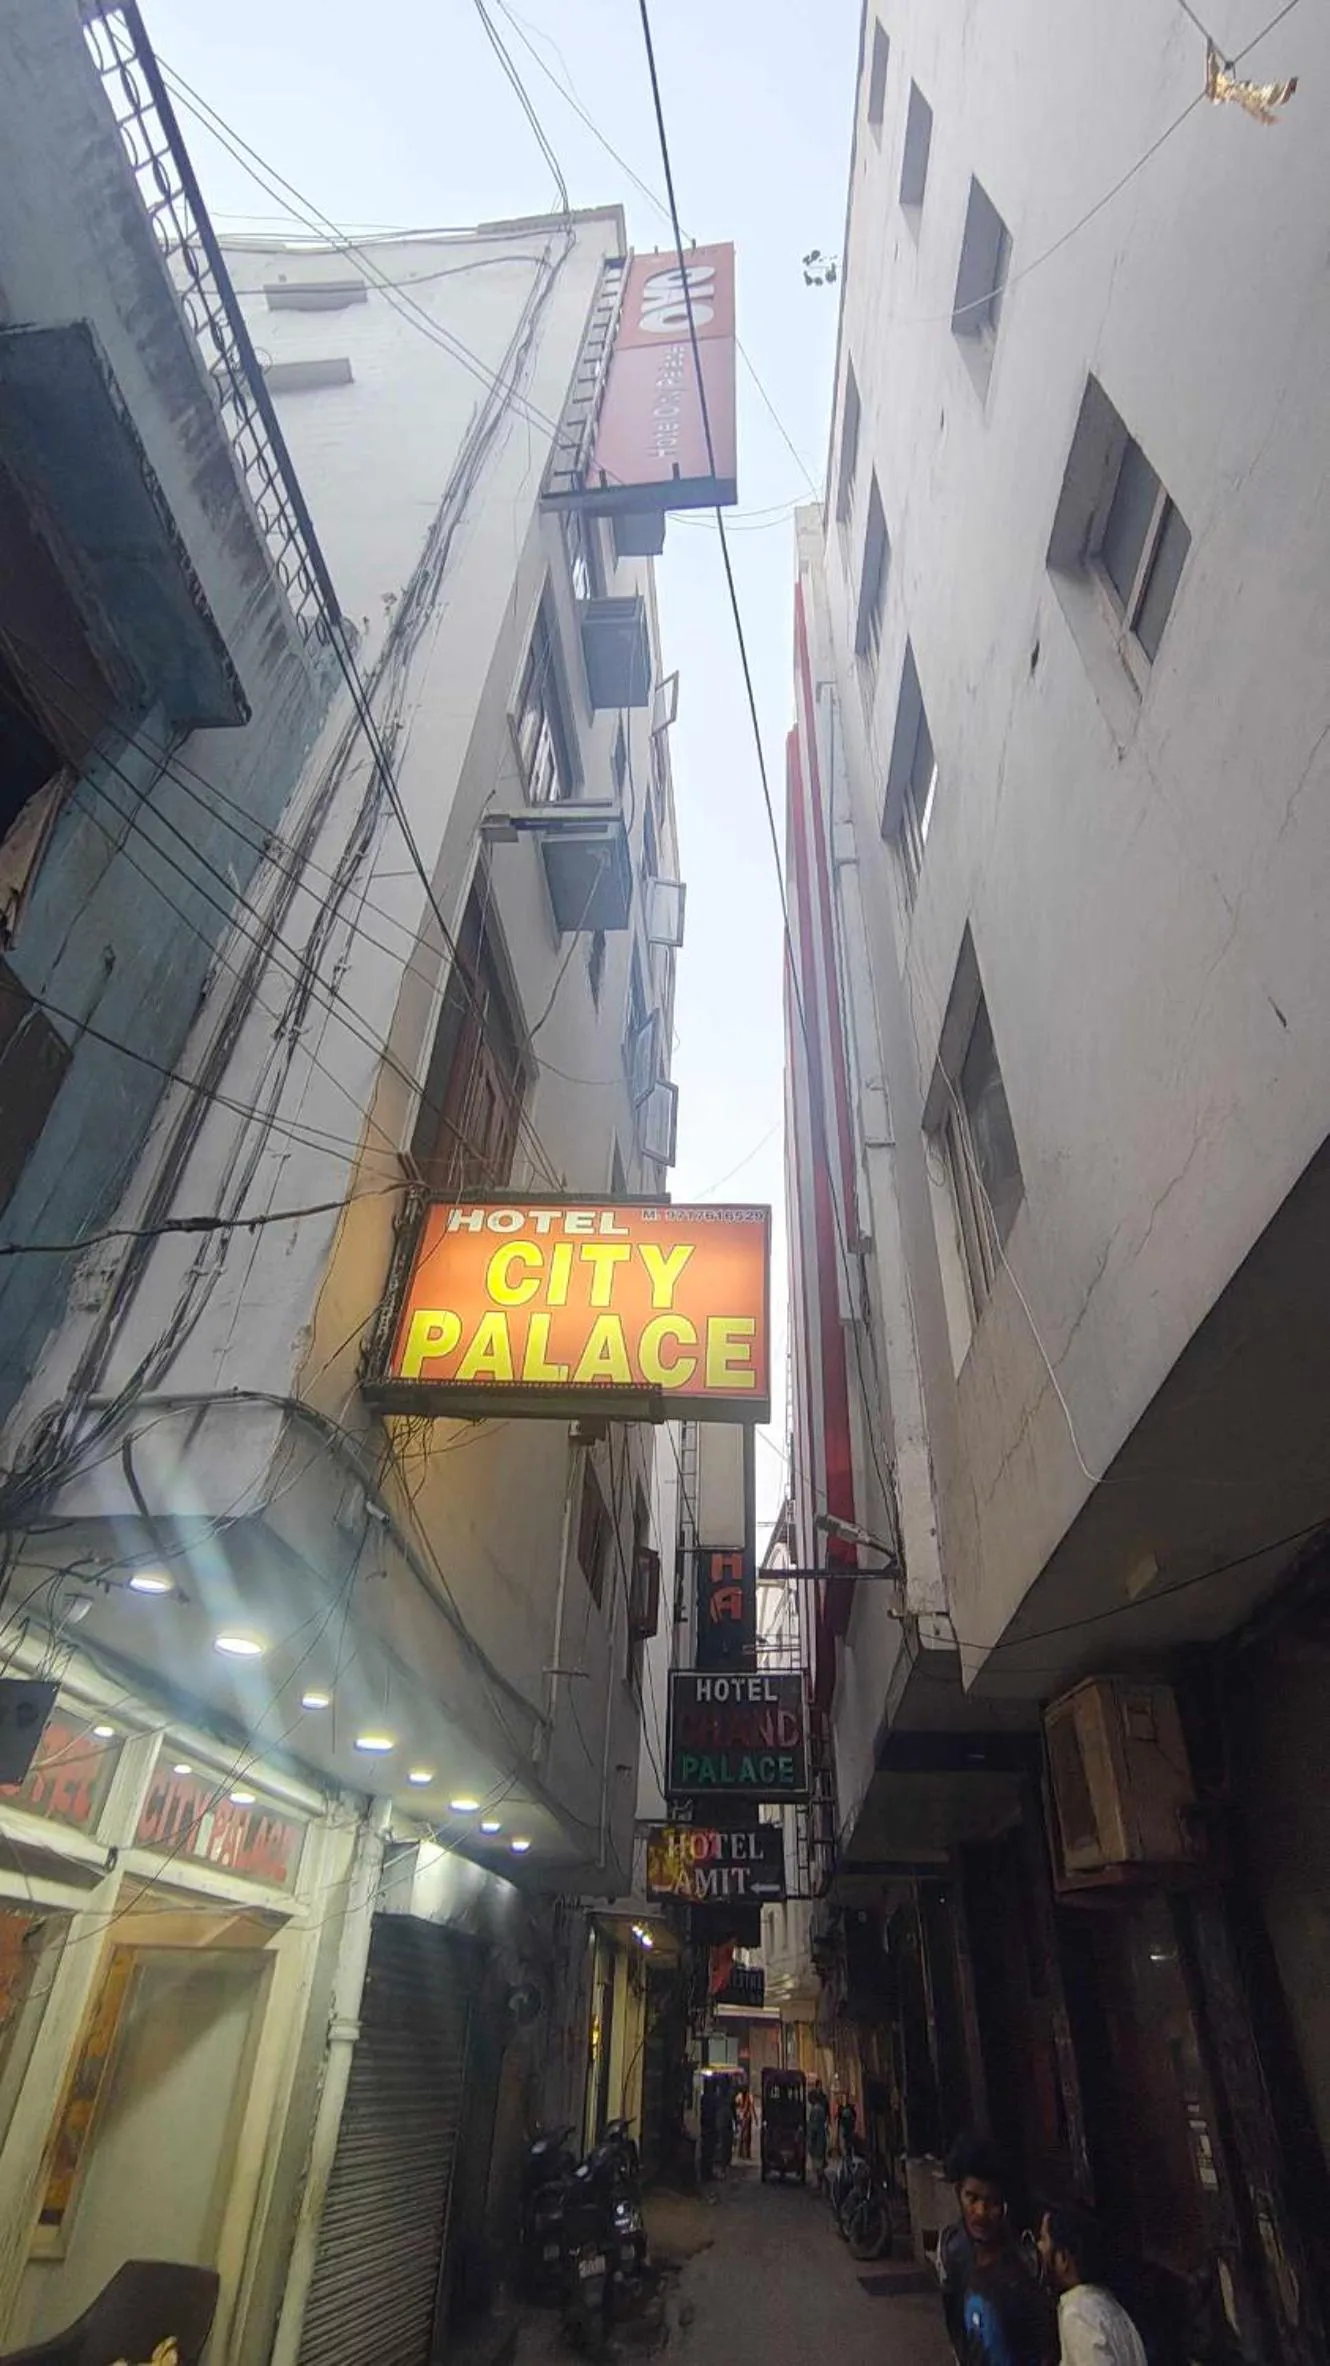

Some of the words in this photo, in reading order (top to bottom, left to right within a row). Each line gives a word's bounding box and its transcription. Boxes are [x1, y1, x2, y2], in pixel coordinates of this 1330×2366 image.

[638, 264, 717, 334] OYO
[447, 1208, 630, 1236] HOTEL
[484, 1239, 696, 1310] CITY
[400, 1308, 757, 1389] PALACE
[696, 1678, 778, 1702] HOTEL
[680, 1755, 794, 1784] PALACE
[667, 1831, 765, 1860] HOTEL
[672, 1867, 751, 1898] AMIT
